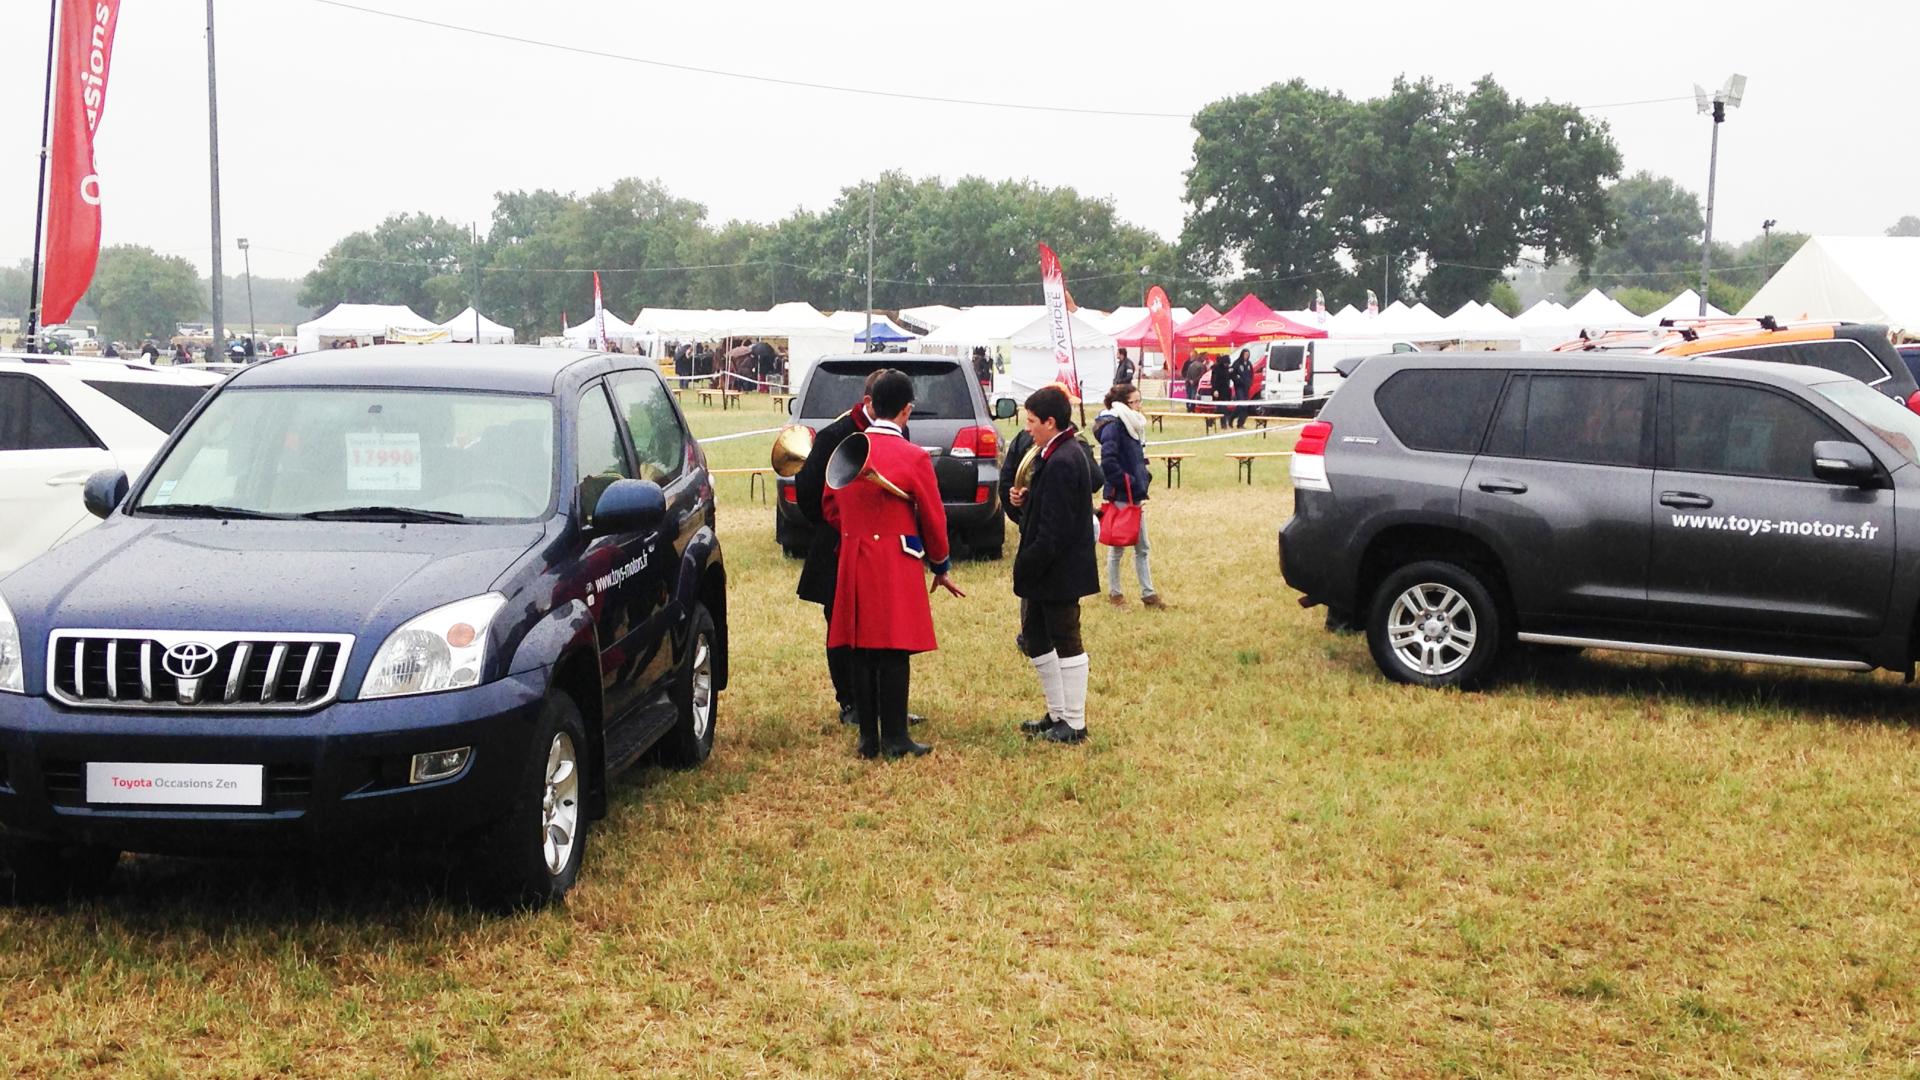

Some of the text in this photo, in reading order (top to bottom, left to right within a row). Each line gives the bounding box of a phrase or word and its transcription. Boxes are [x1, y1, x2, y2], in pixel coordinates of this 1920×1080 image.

[1671, 513, 1879, 540] www.toys-motors.fr
[594, 548, 649, 594] www.toys-motors.fr
[111, 776, 238, 790] Toyota Occasions Zen
